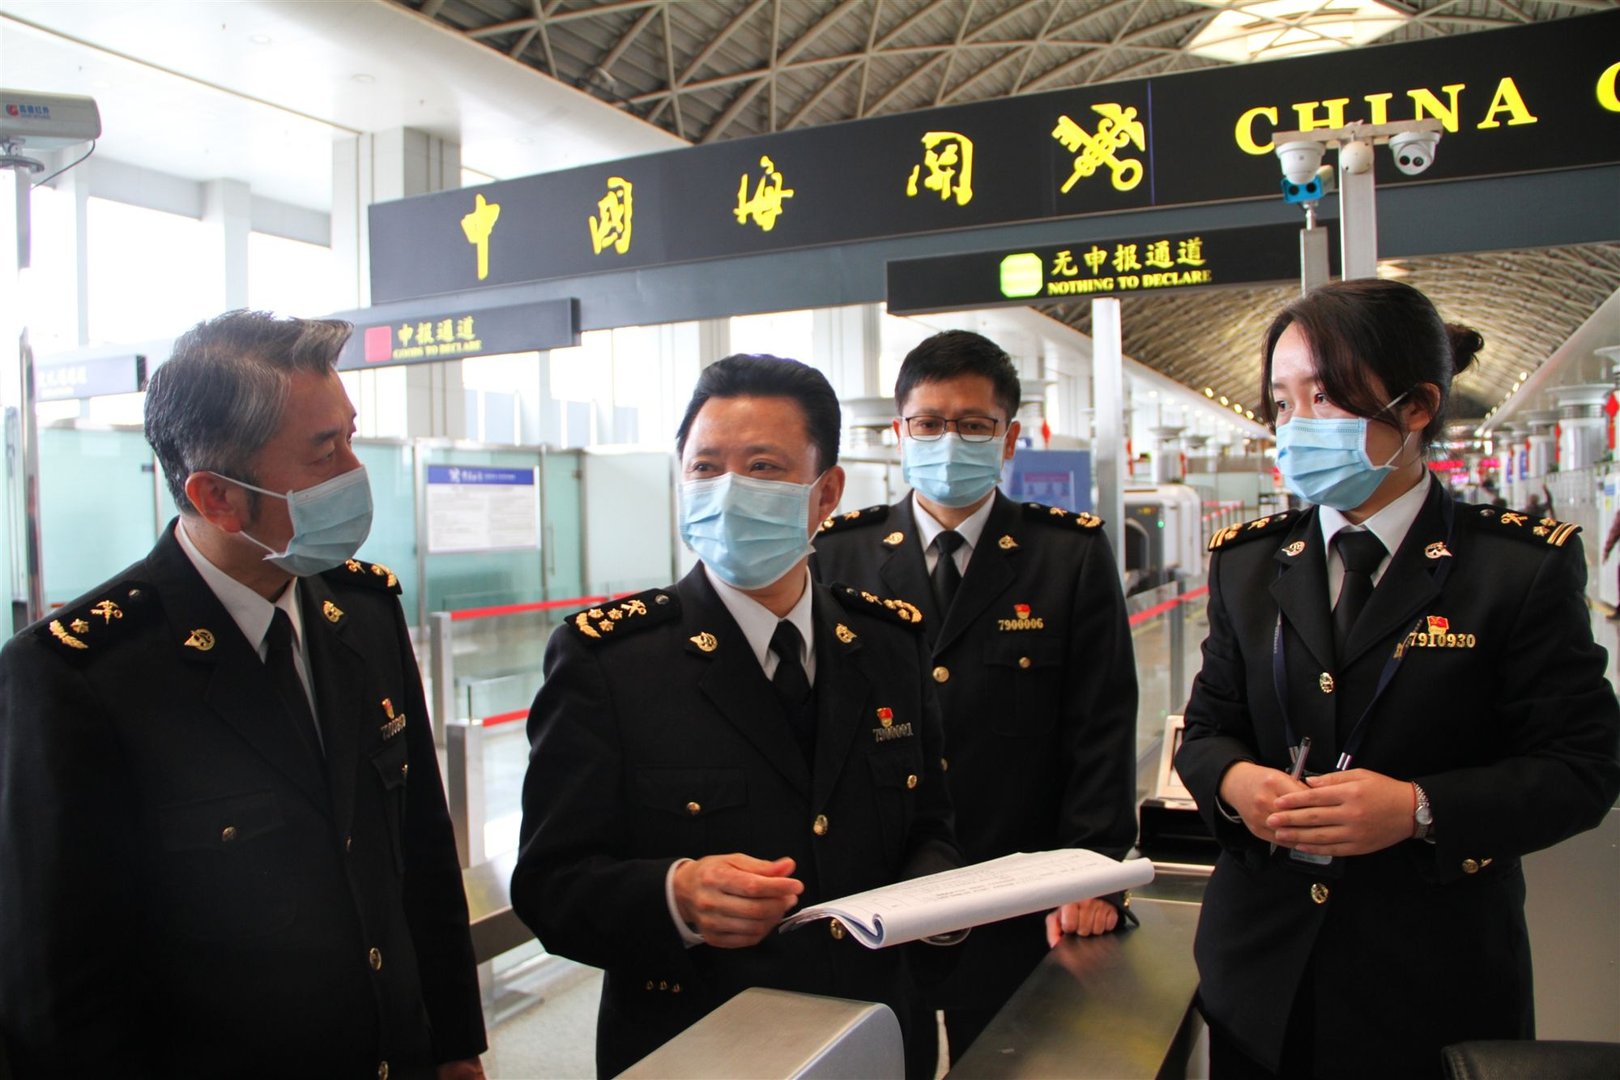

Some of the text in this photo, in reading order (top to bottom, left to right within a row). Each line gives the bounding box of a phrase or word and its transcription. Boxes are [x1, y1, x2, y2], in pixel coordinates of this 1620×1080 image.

[1234, 77, 1538, 155] CHINA
[1051, 236, 1207, 278] 无申报通道
[1047, 269, 1213, 296] NOTHING TO DECLARE
[397, 315, 477, 348] 申报通道
[998, 617, 1044, 631] 7900006
[1410, 632, 1475, 648] 7910930
